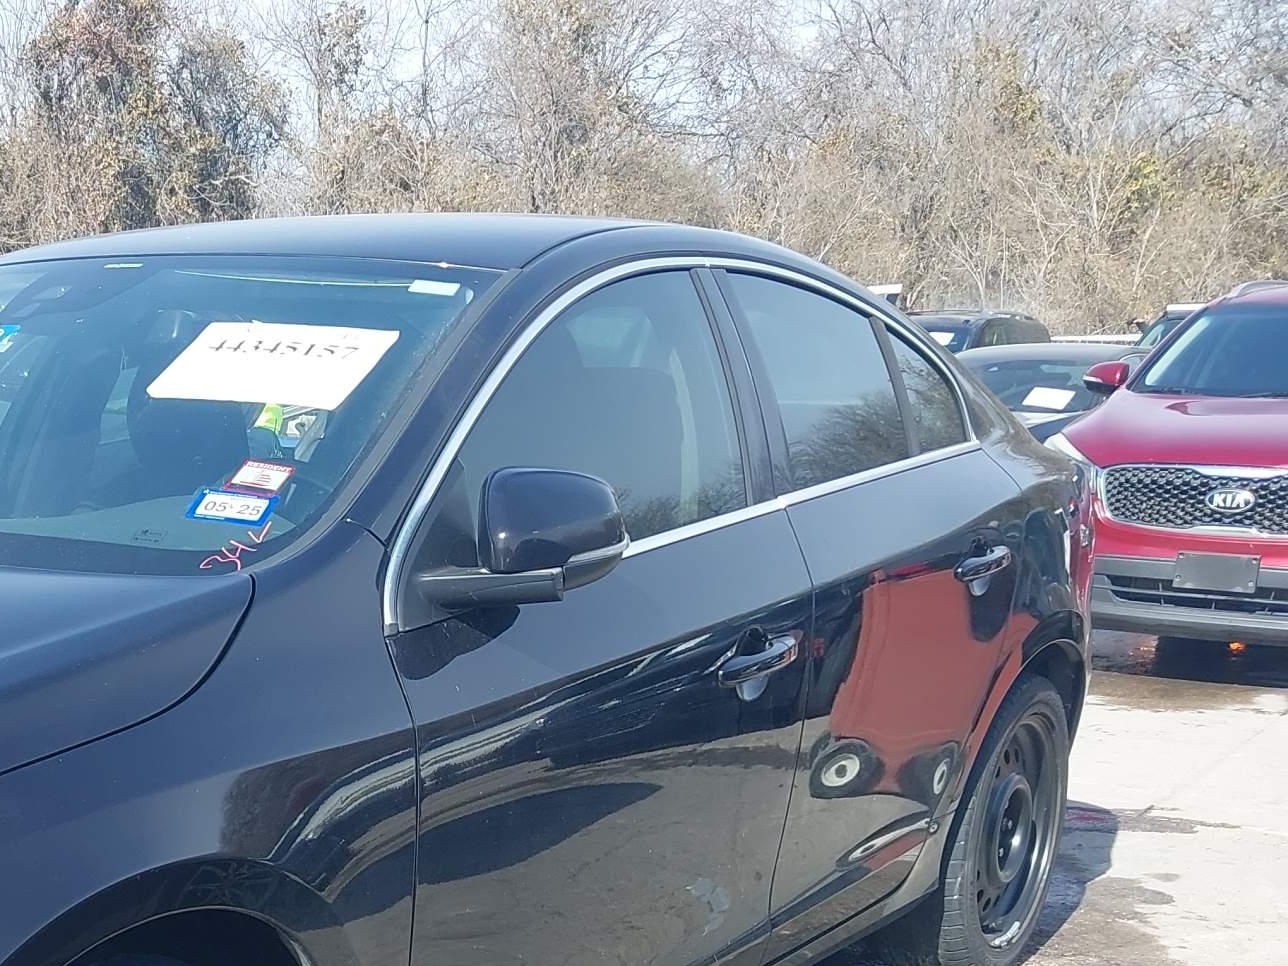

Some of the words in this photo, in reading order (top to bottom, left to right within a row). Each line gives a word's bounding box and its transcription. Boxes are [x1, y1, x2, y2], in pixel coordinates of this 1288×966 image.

[245, 460, 294, 473] RESIDENT
[1212, 493, 1246, 508] KIA
[203, 500, 229, 513] 05
[236, 504, 263, 517] 25
